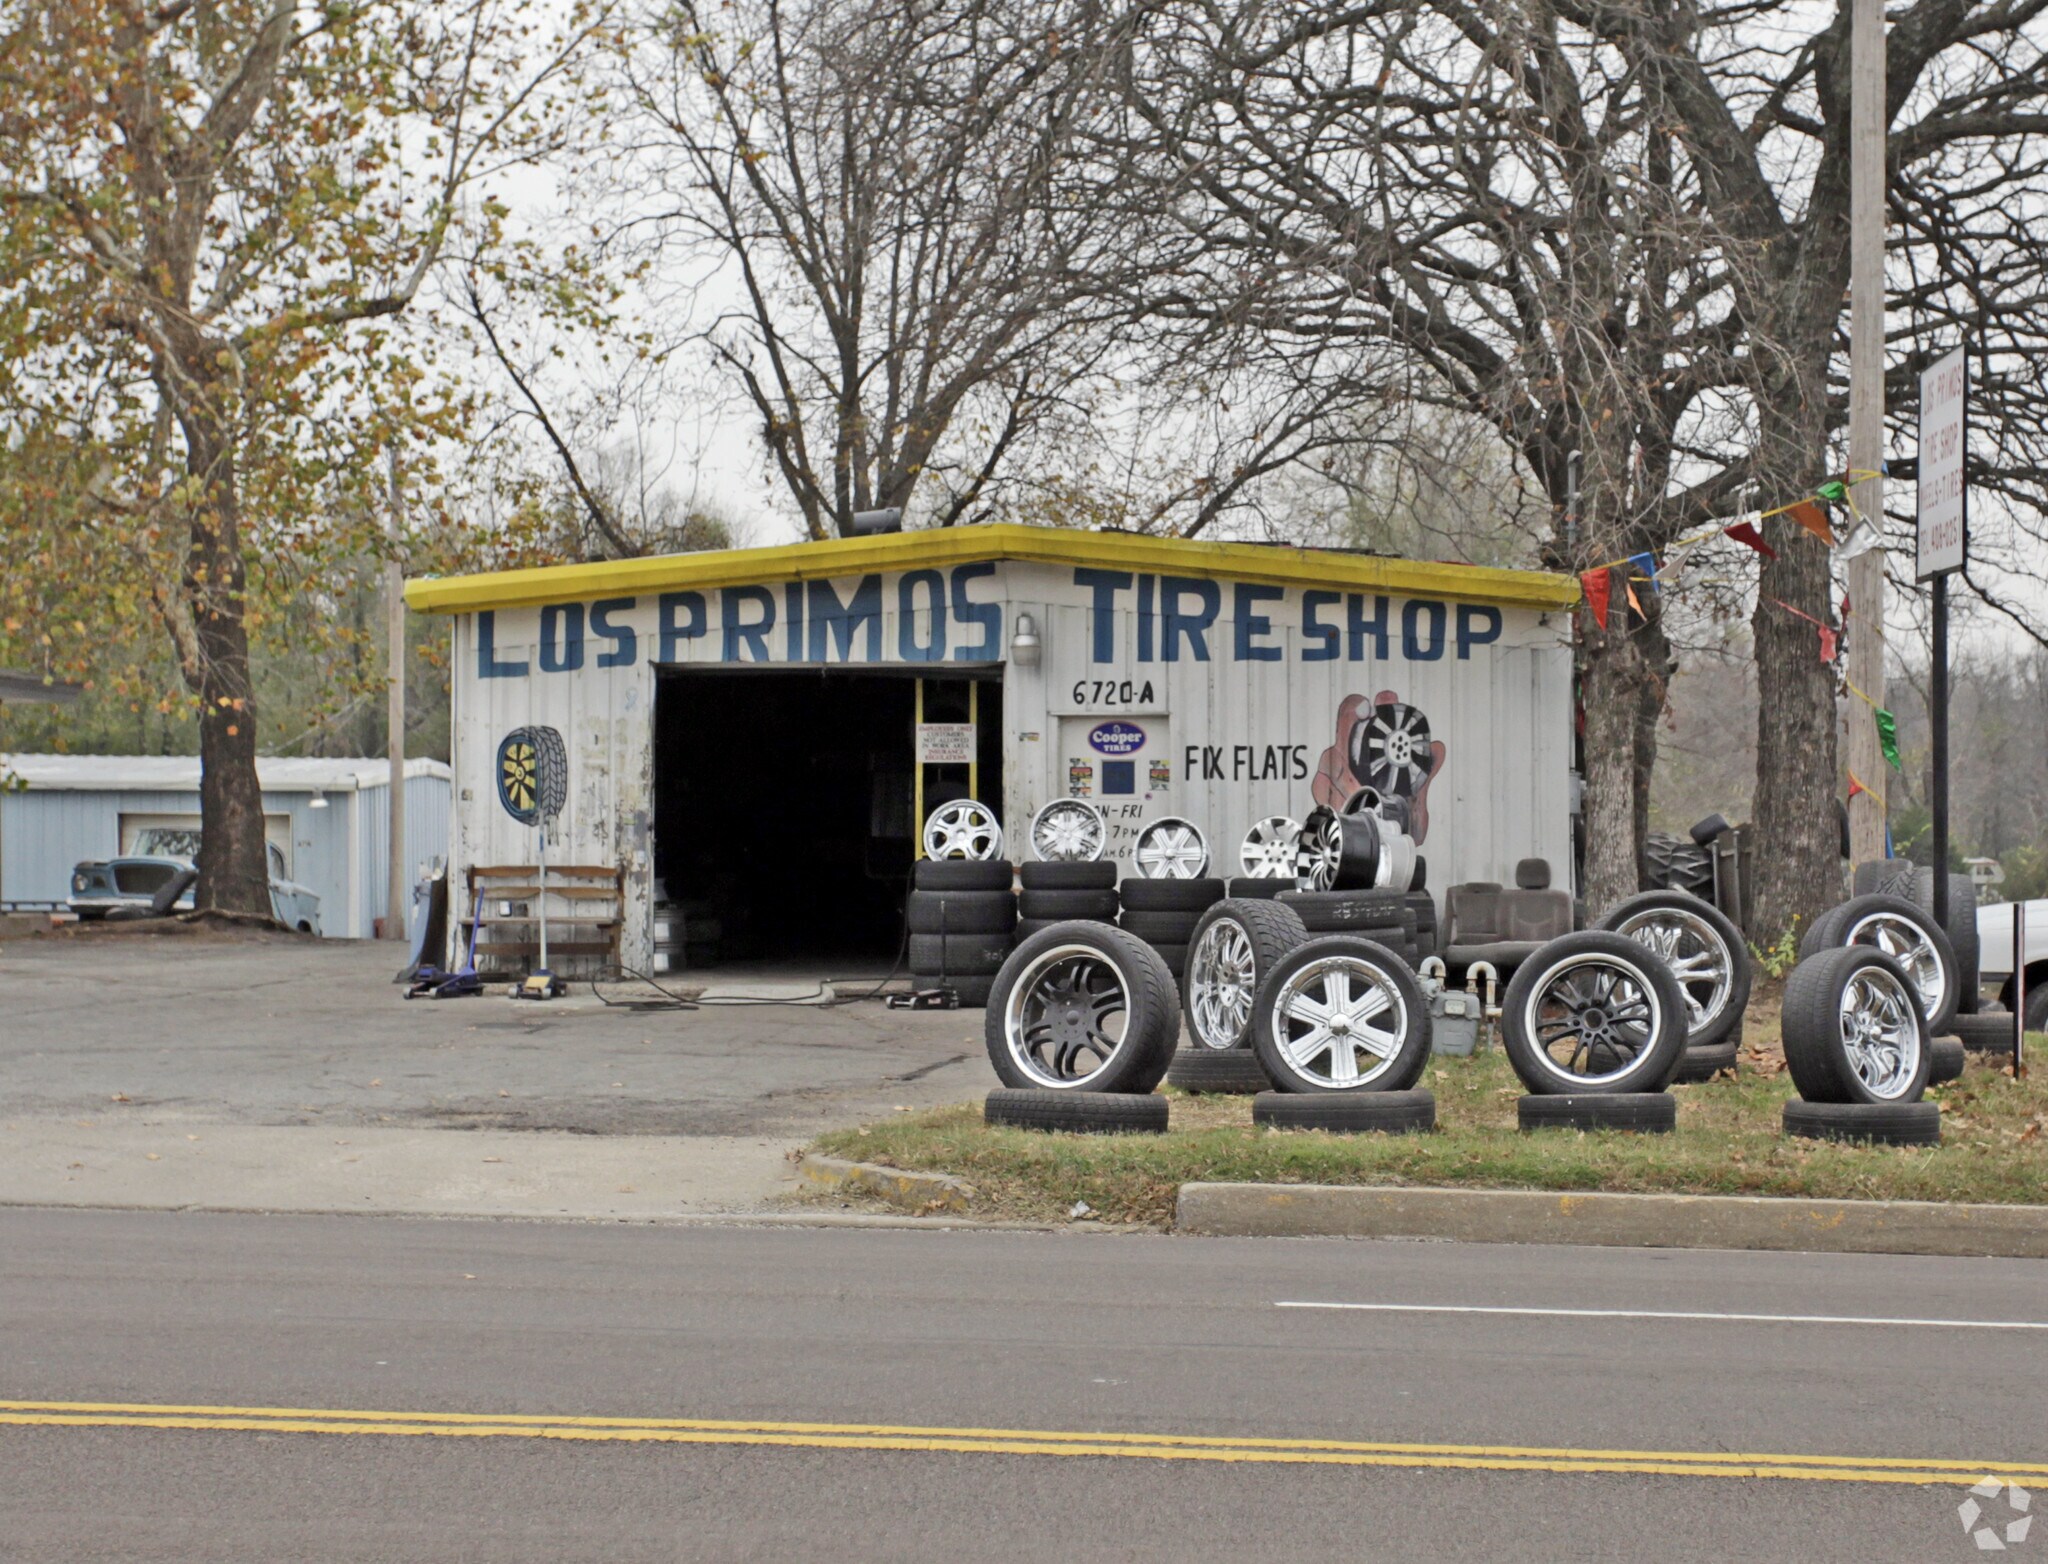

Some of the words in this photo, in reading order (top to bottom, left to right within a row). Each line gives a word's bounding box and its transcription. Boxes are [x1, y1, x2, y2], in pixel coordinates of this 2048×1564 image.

[1924, 380, 1934, 416] LOS
[1937, 363, 1962, 406] PRIMOS
[1924, 431, 1938, 466] TIRE
[1940, 421, 1959, 460] SHOP
[479, 598, 637, 678] LOS
[659, 563, 1002, 663] PRIMOS
[1074, 567, 1283, 664] TIRE
[1302, 590, 1503, 662] SHOP
[1073, 680, 1154, 705] 6720-A
[1092, 731, 1142, 745] Cooper
[1103, 744, 1132, 752] TIRES
[1185, 745, 1225, 782] FIX
[1233, 744, 1308, 782] FLATS
